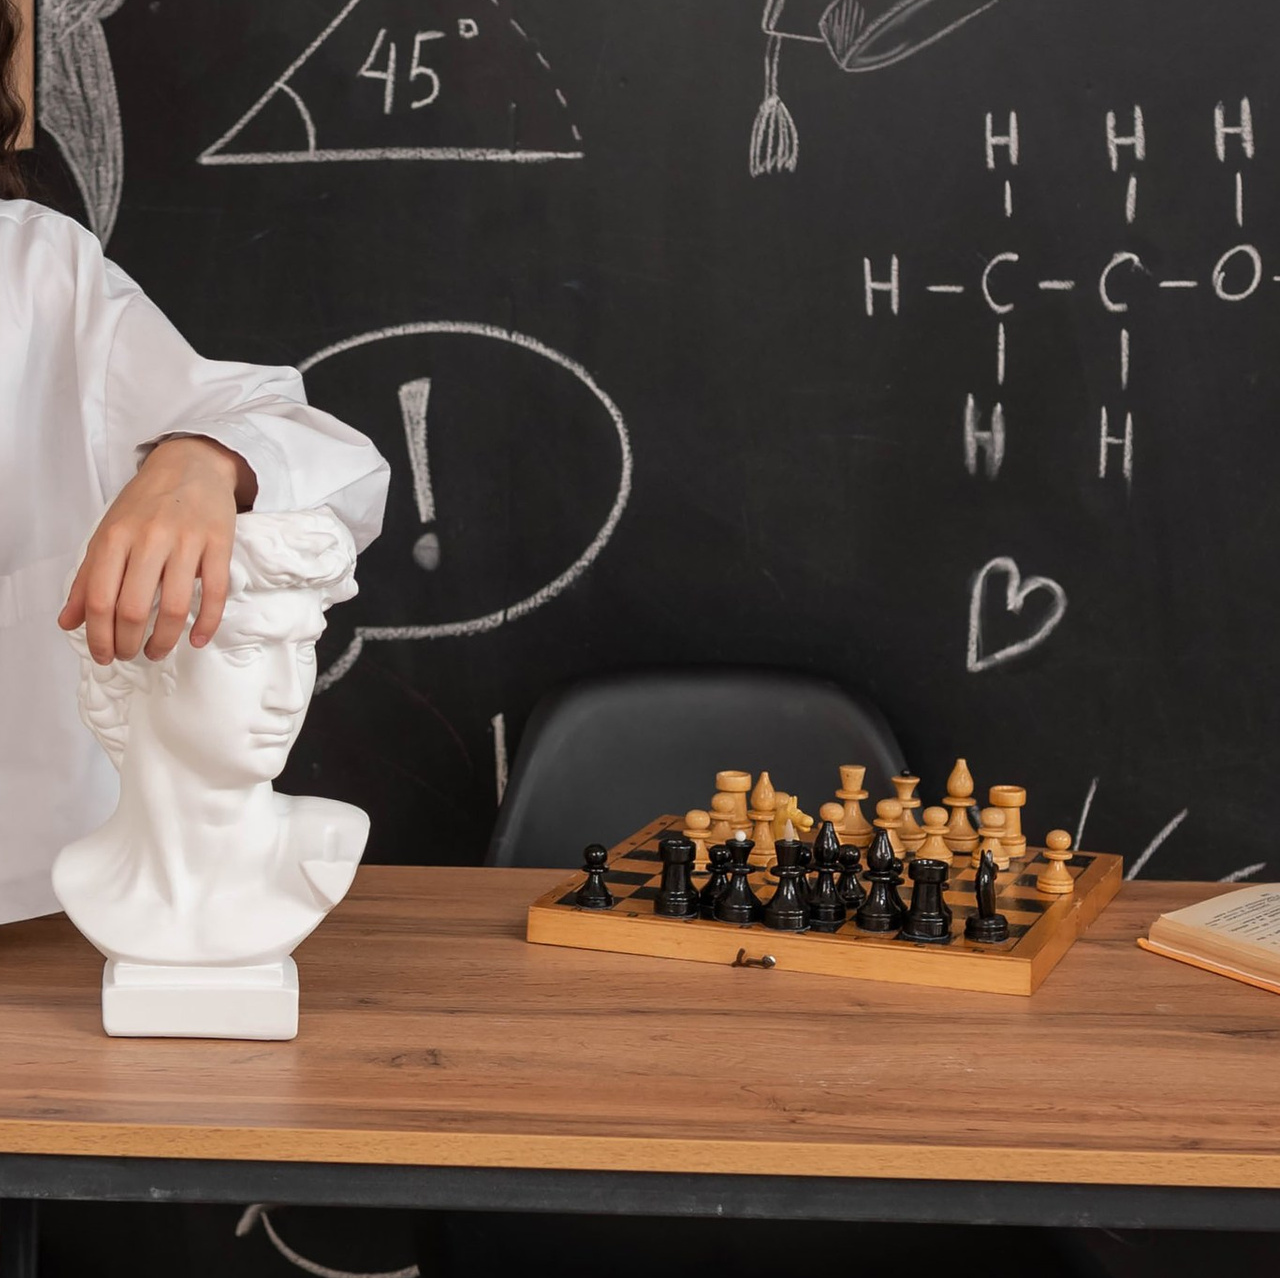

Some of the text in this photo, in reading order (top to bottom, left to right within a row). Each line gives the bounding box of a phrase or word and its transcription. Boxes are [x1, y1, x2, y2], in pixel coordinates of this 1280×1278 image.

[985, 96, 1255, 169] H H H
